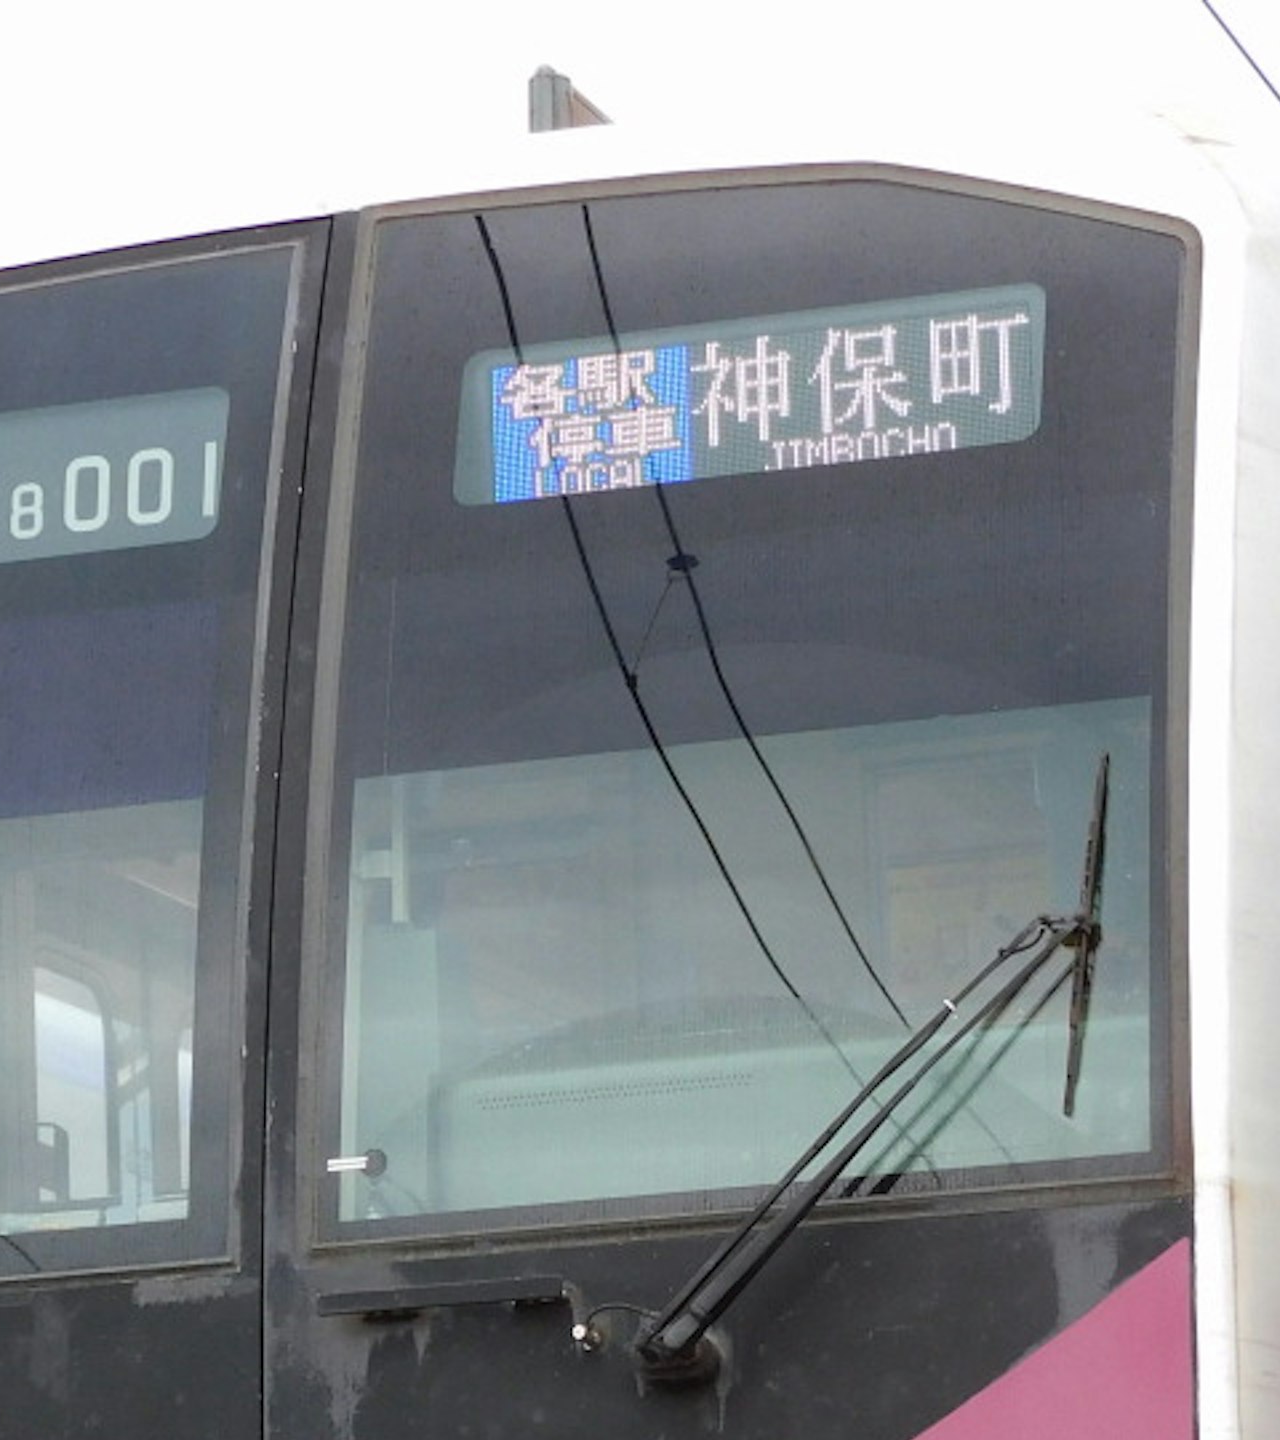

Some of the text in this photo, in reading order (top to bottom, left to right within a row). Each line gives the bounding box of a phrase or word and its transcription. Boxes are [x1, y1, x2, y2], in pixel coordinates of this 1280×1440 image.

[500, 349, 656, 420] 各駅
[689, 313, 1029, 447] 神保町
[529, 406, 681, 468] 停車
